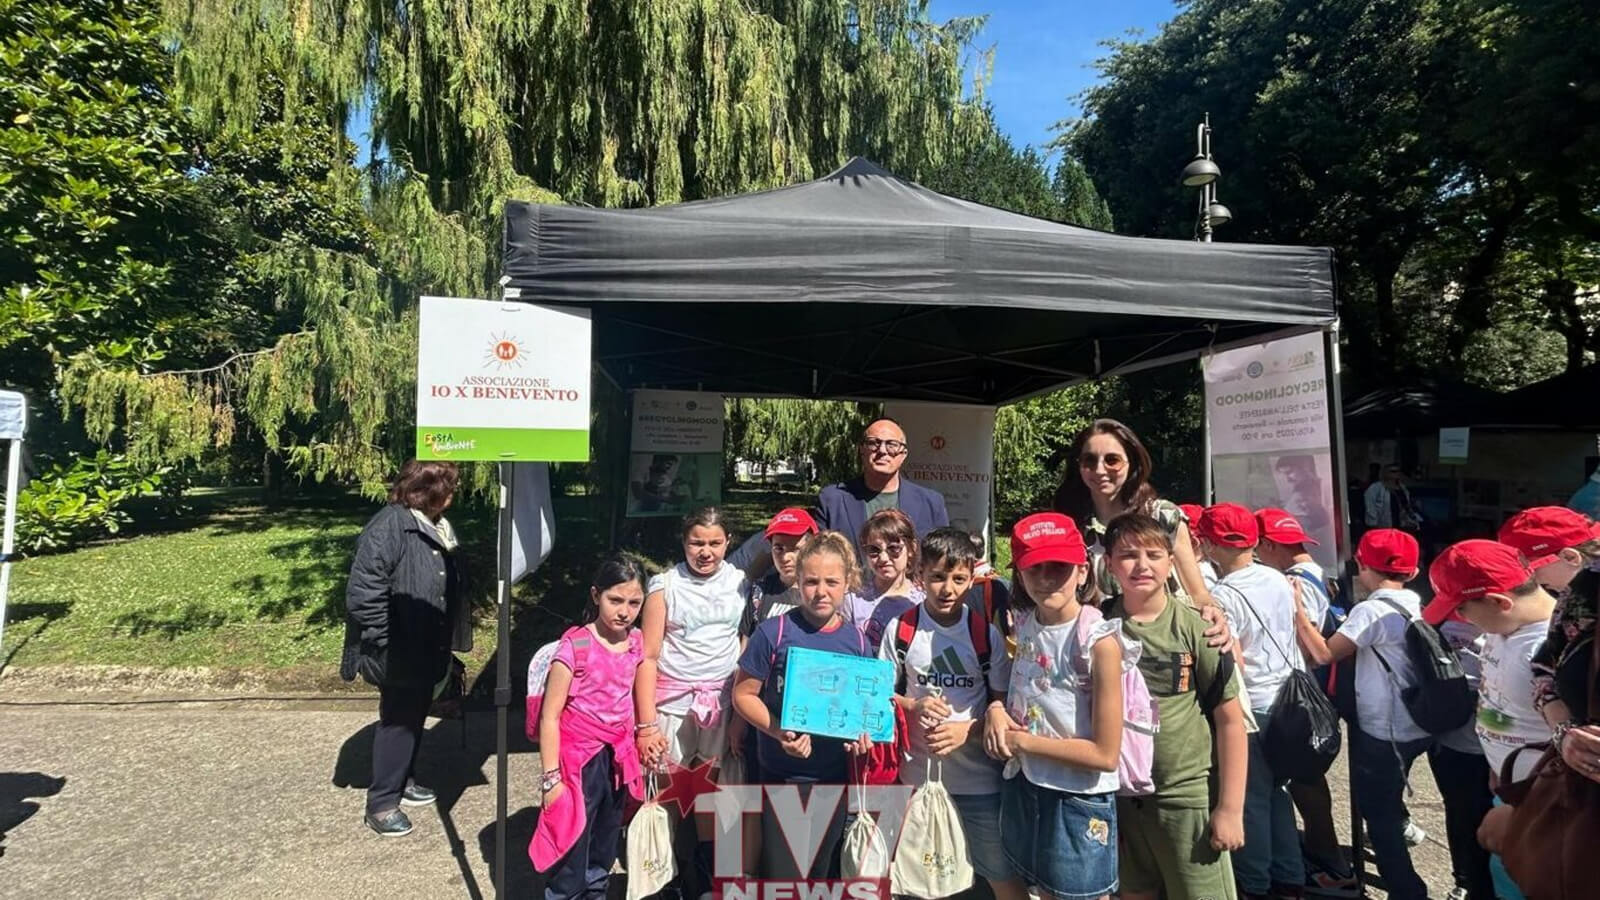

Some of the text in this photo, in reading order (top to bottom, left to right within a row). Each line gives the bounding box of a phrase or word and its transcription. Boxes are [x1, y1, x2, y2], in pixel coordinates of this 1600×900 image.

[462, 376, 549, 388] ASSOCIAZIONE
[431, 385, 579, 402] IO X BENEVENTO
[914, 471, 989, 483] BENEVENTO
[917, 672, 974, 688] adidas
